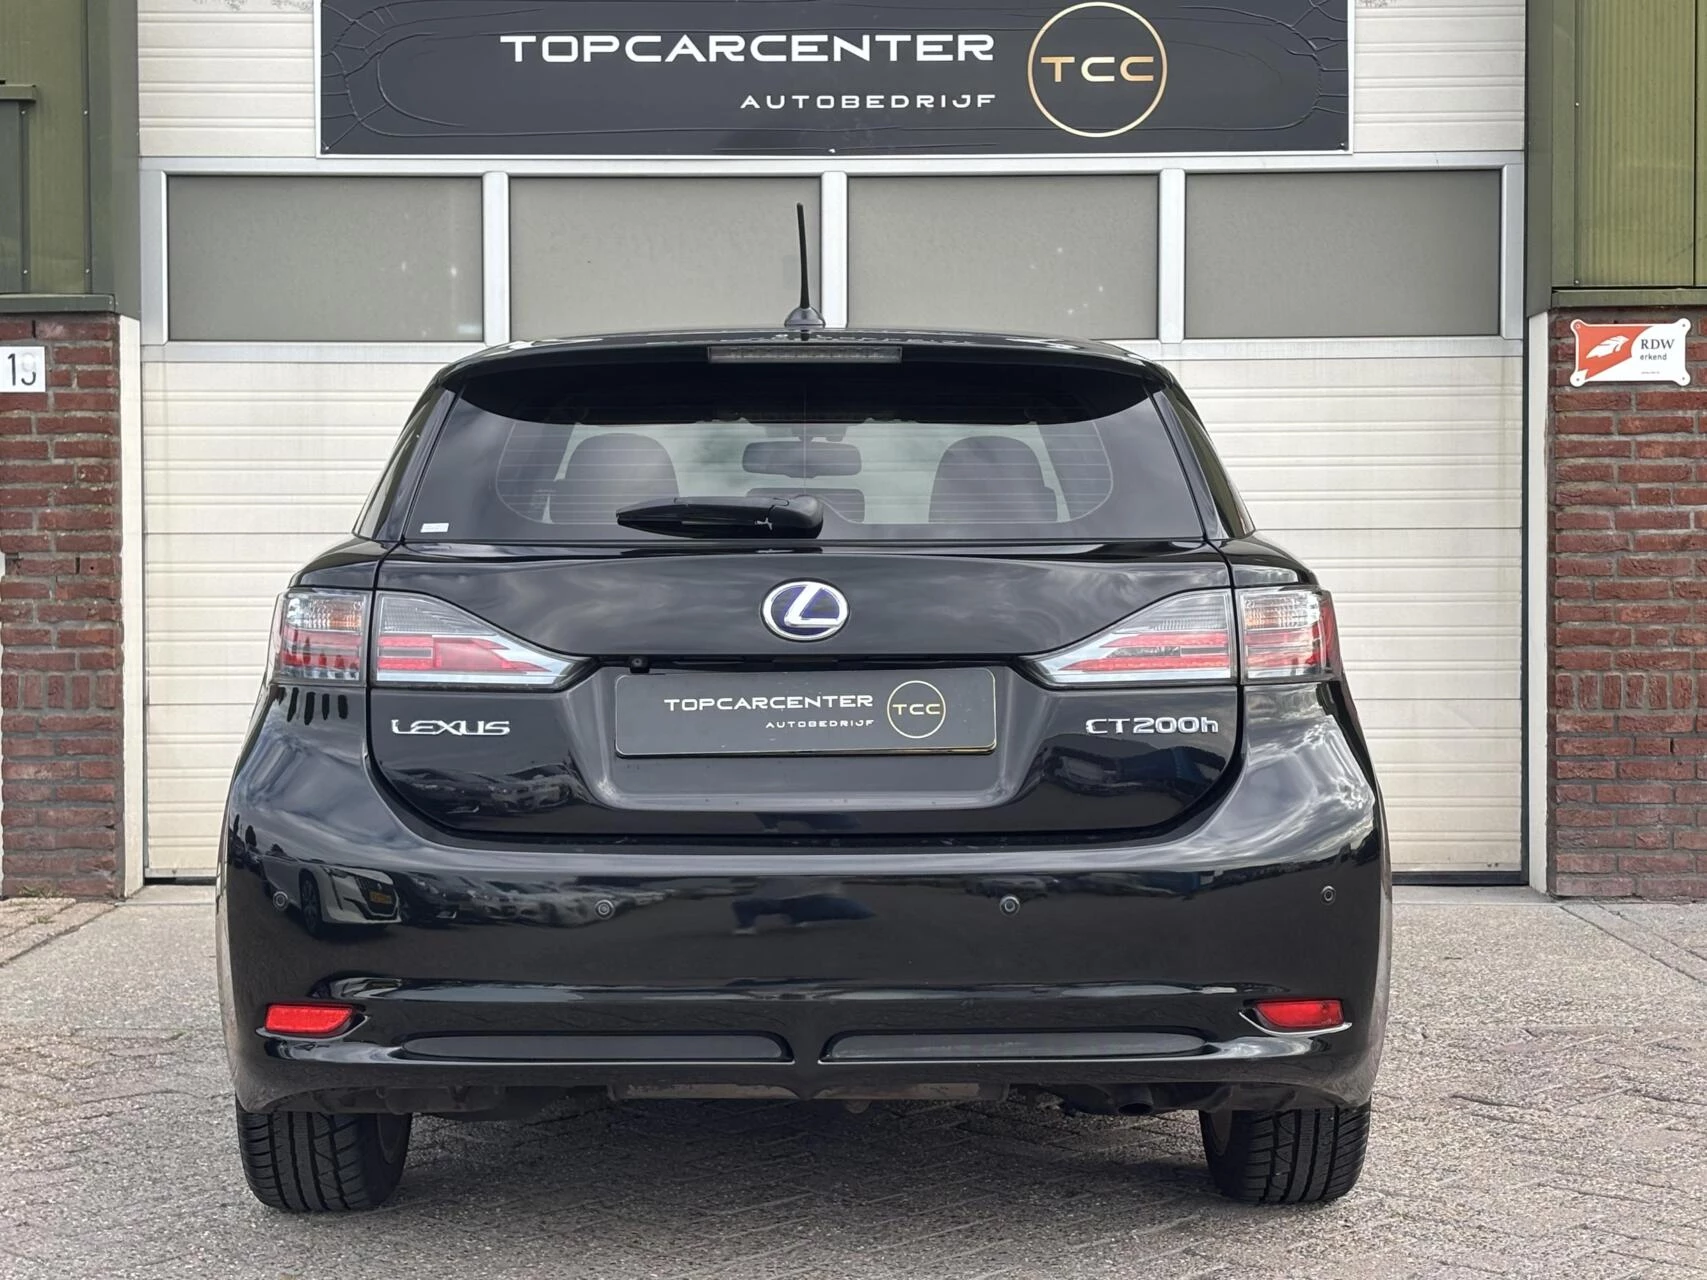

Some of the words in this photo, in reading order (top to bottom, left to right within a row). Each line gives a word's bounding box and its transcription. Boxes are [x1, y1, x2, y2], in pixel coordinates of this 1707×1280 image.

[499, 34, 995, 63] TOPCARCENTER
[1040, 55, 1155, 83] TCC
[740, 94, 997, 110] AUTOBEDRIJF
[1640, 338, 1675, 350] RDW
[1639, 352, 1667, 361] erkend
[663, 694, 874, 712] TOPCARCENTER
[891, 703, 942, 717] TCC
[390, 719, 511, 736] LEXUS
[763, 719, 875, 729] AUTOBEDRIJF
